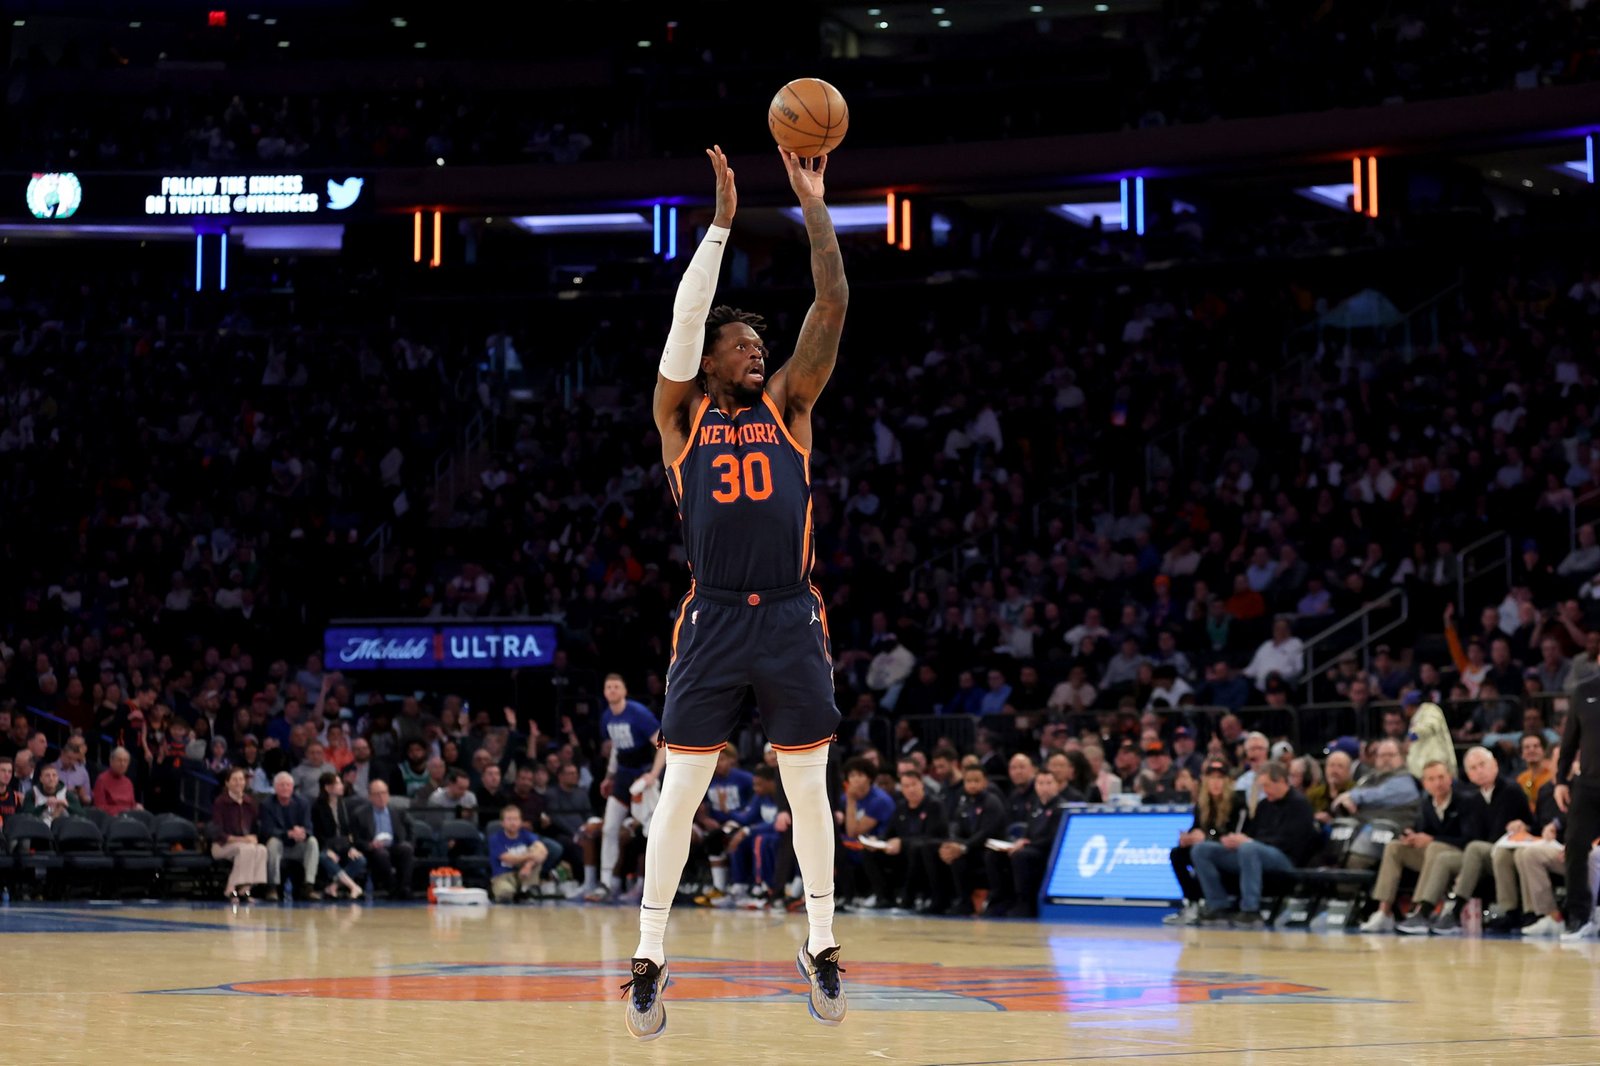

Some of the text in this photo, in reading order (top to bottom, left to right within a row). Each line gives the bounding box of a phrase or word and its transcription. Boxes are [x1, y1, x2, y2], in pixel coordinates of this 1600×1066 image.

[162, 175, 303, 195] FOLLOW THE KNICKS
[145, 196, 167, 214] ON
[168, 195, 231, 214] TWITTER
[699, 423, 780, 446] NEW YORK
[712, 452, 773, 503] 30
[451, 635, 542, 658] ULTRA
